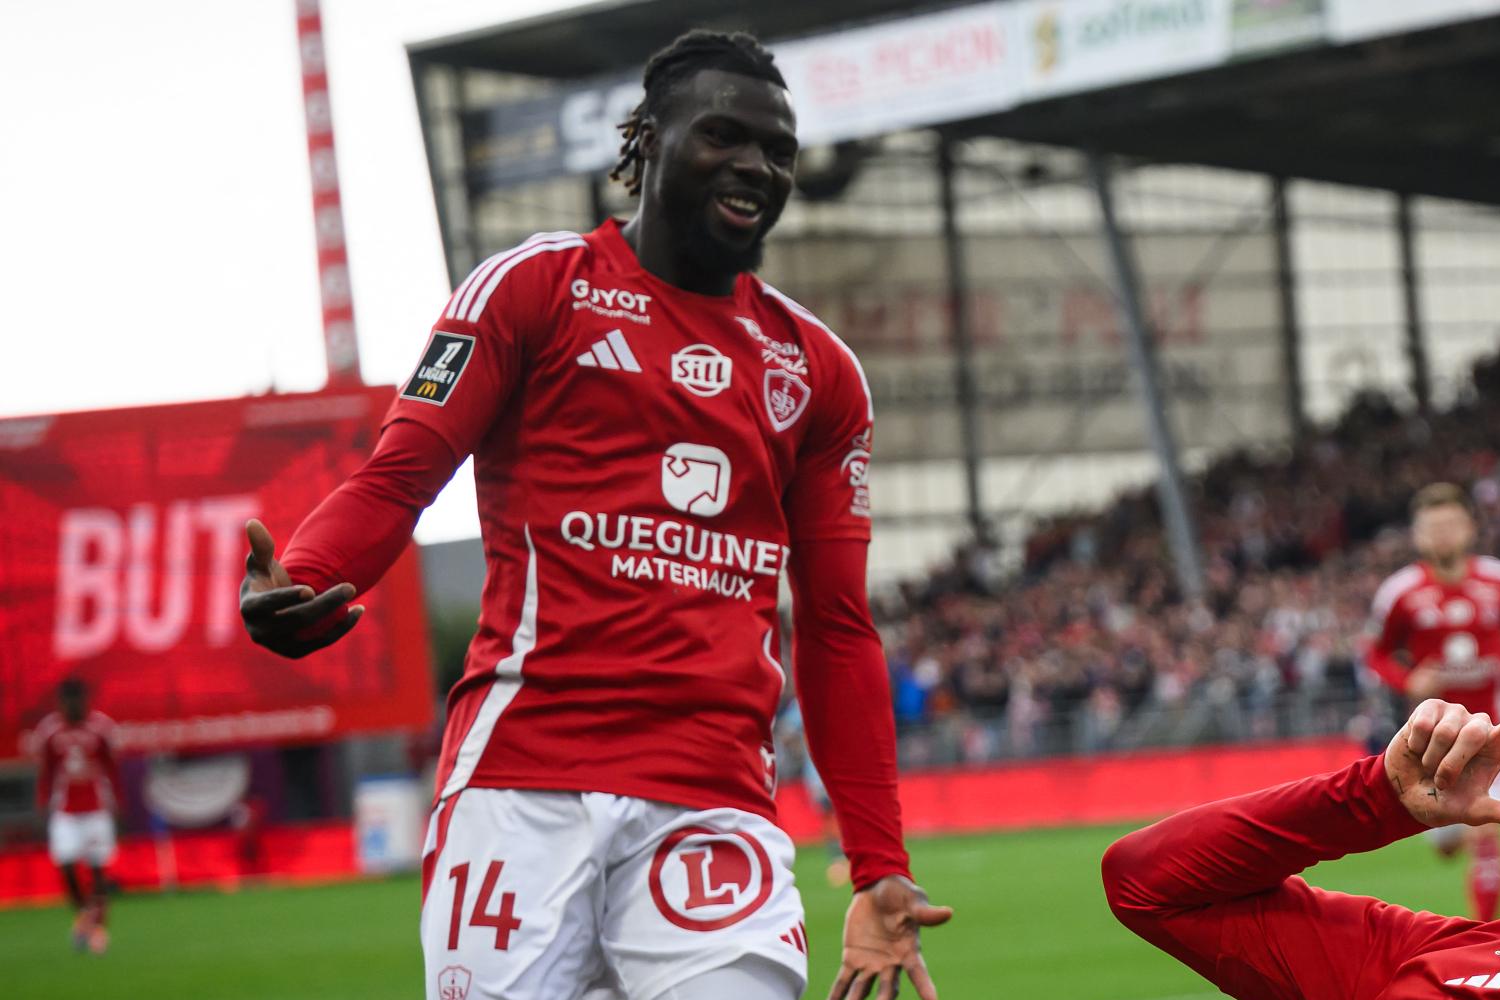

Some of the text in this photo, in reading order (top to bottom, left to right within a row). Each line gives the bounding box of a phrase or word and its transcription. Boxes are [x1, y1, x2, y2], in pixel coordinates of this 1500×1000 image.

[677, 358, 727, 385] Sill
[560, 510, 791, 577] QUEGUINE
[53, 497, 260, 658] BUT
[611, 554, 754, 602] MATERIAUX
[447, 860, 522, 951] 14
